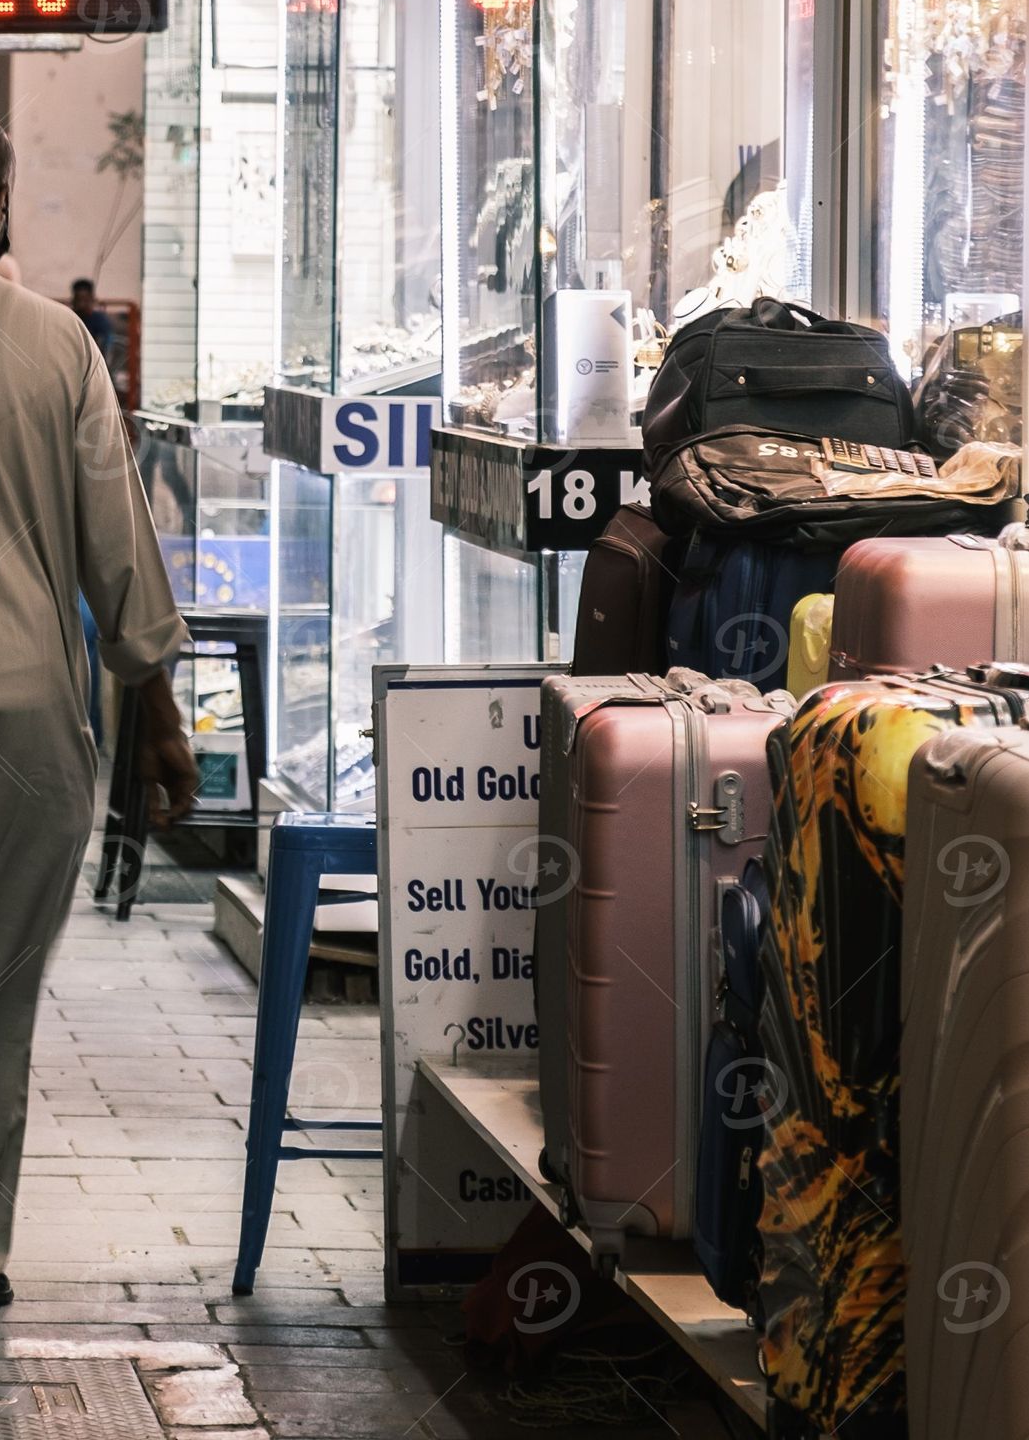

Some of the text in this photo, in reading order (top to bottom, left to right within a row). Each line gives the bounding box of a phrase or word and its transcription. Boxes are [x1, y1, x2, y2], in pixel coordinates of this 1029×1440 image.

[527, 469, 597, 520] 18
[412, 767, 464, 802] Old
[407, 878, 467, 912] Sell
[404, 947, 480, 984] Gold,
